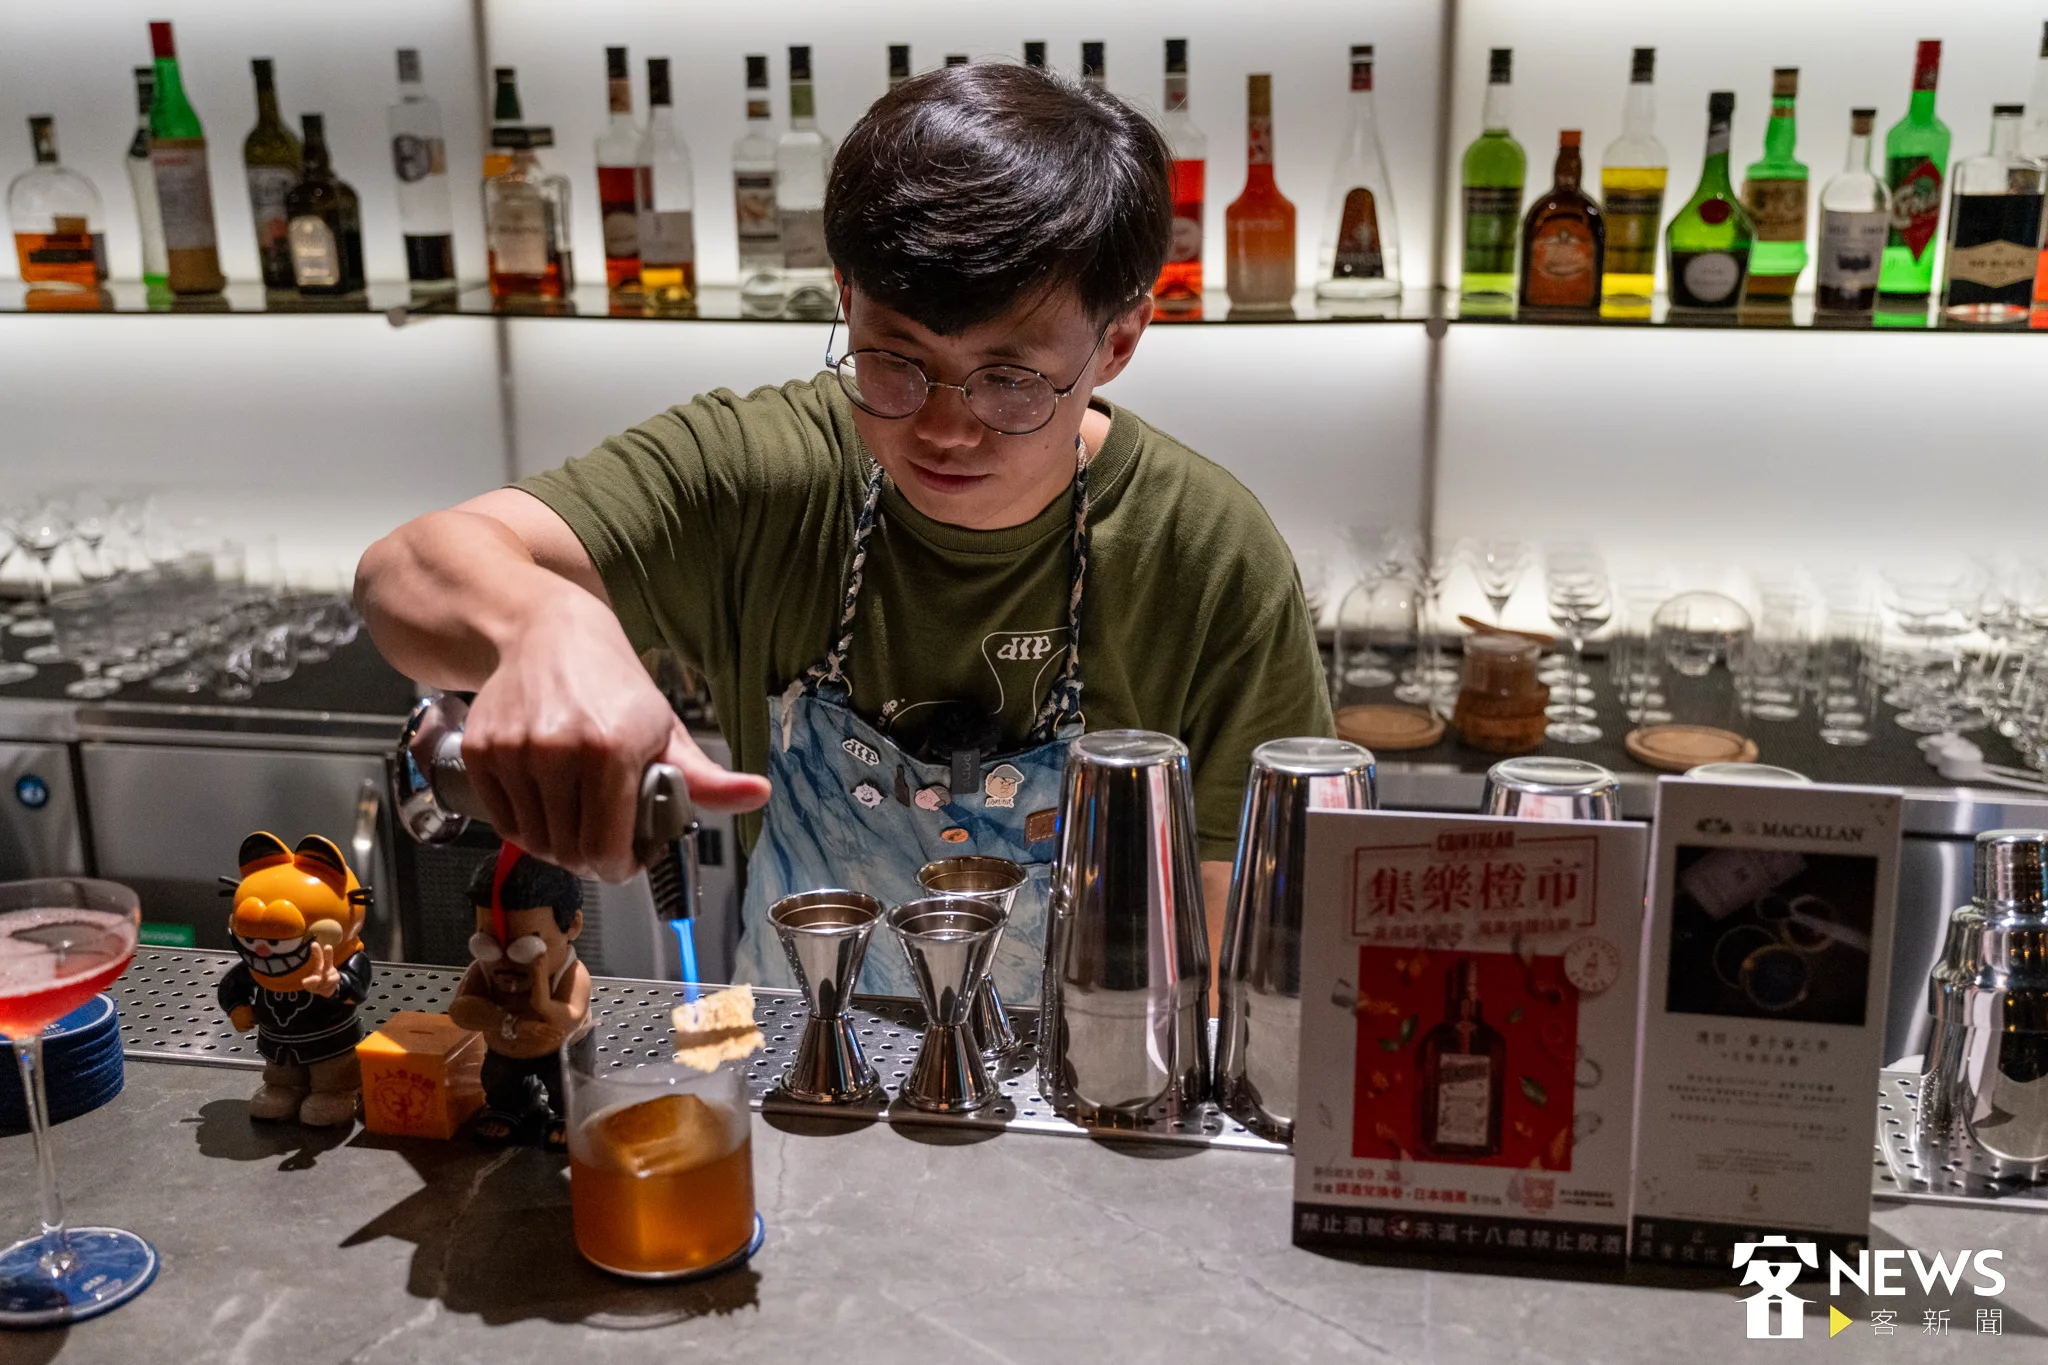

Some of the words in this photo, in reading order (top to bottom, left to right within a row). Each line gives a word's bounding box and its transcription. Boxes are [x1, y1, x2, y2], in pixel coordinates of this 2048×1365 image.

[1761, 821, 1865, 842] MACALLAN
[1367, 857, 1583, 917] 集樂橙市
